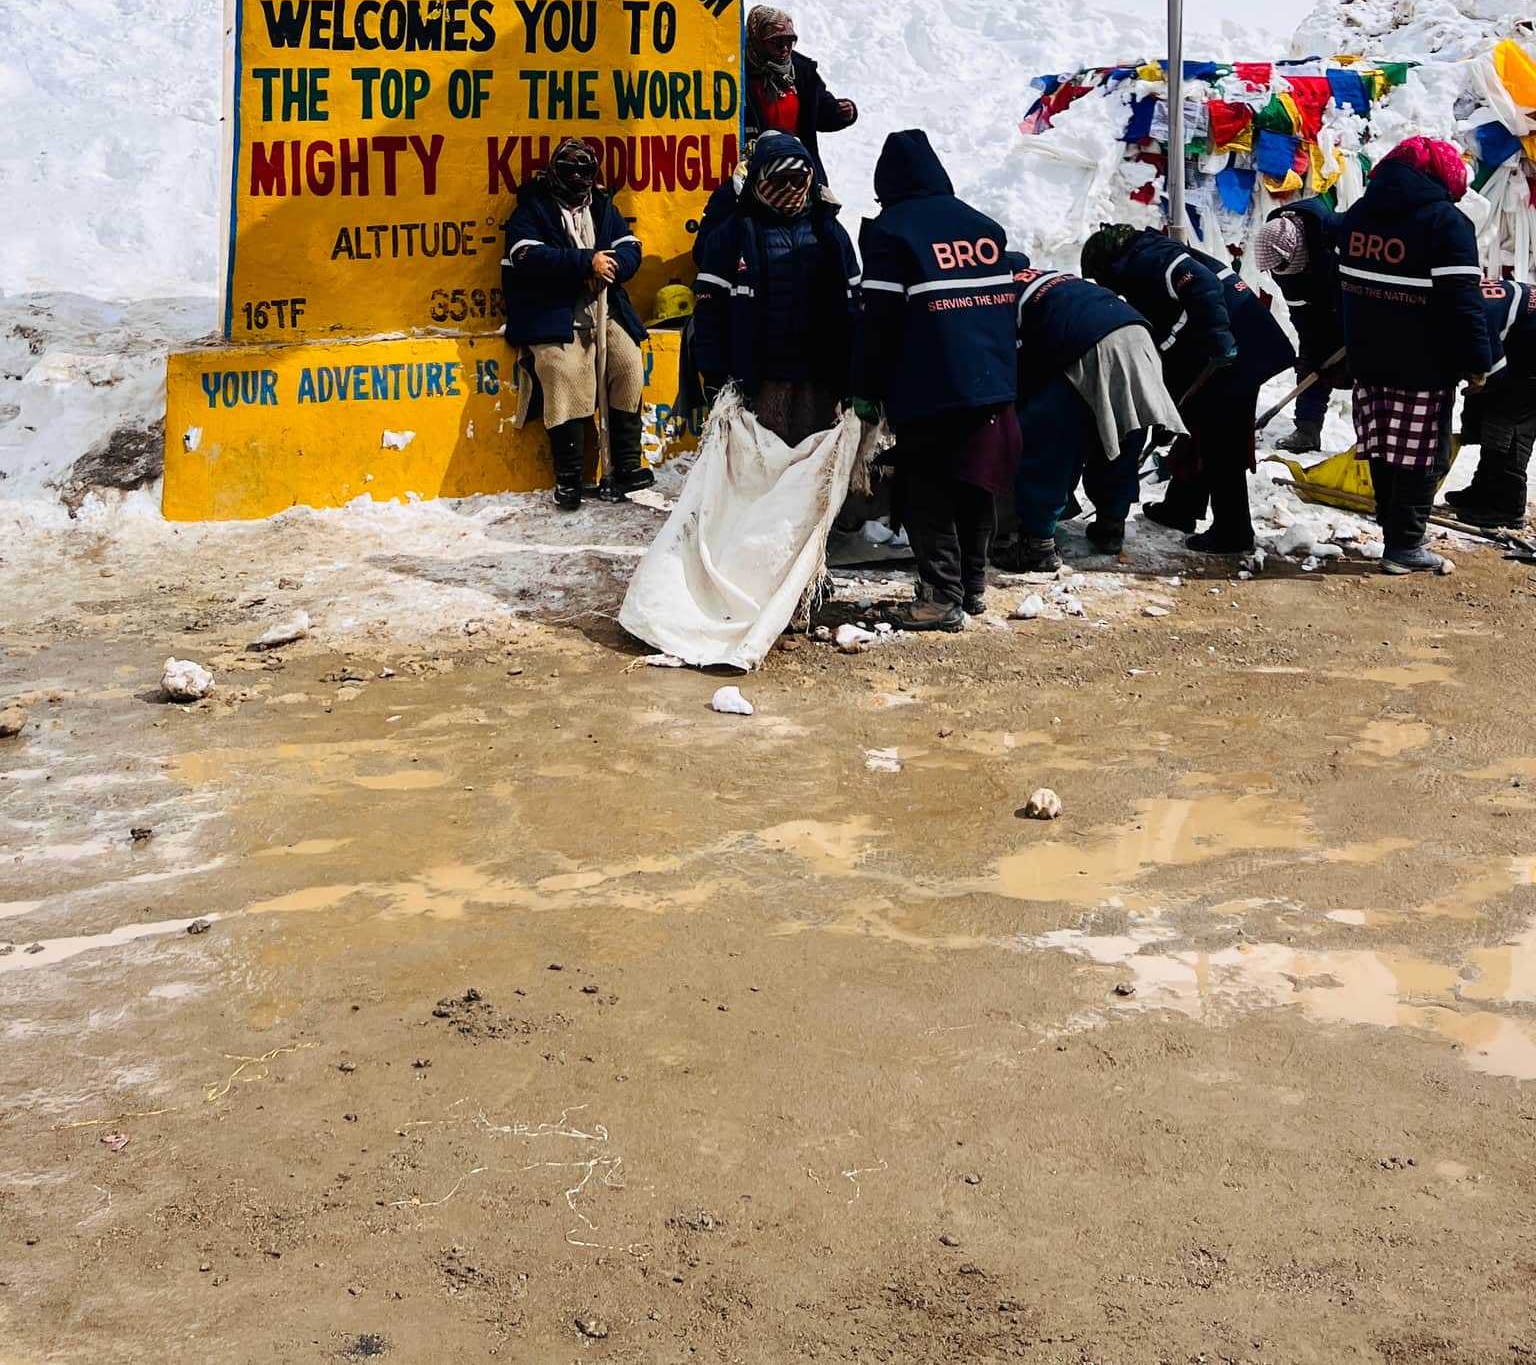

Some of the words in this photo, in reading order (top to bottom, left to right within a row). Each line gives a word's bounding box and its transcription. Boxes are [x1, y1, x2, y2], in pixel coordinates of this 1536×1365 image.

[261, 0, 496, 52] WELCOMES
[515, 0, 597, 53] YOU
[623, 1, 676, 54] TO
[252, 68, 330, 122] THE
[351, 68, 430, 120] TOP
[449, 69, 493, 119] OF
[519, 70, 600, 120] THE
[612, 70, 738, 121] WORLD
[250, 134, 445, 196] MIGHTY
[487, 134, 738, 194] KHDUNGLA
[932, 237, 1000, 270] BRO
[1349, 231, 1406, 265] BRO
[243, 298, 307, 330] 16TF
[928, 296, 973, 312] SERVING
[975, 294, 992, 306] THE
[201, 370, 278, 409] YOUR
[297, 362, 462, 404] ADVENTURE
[476, 360, 500, 395] IS
